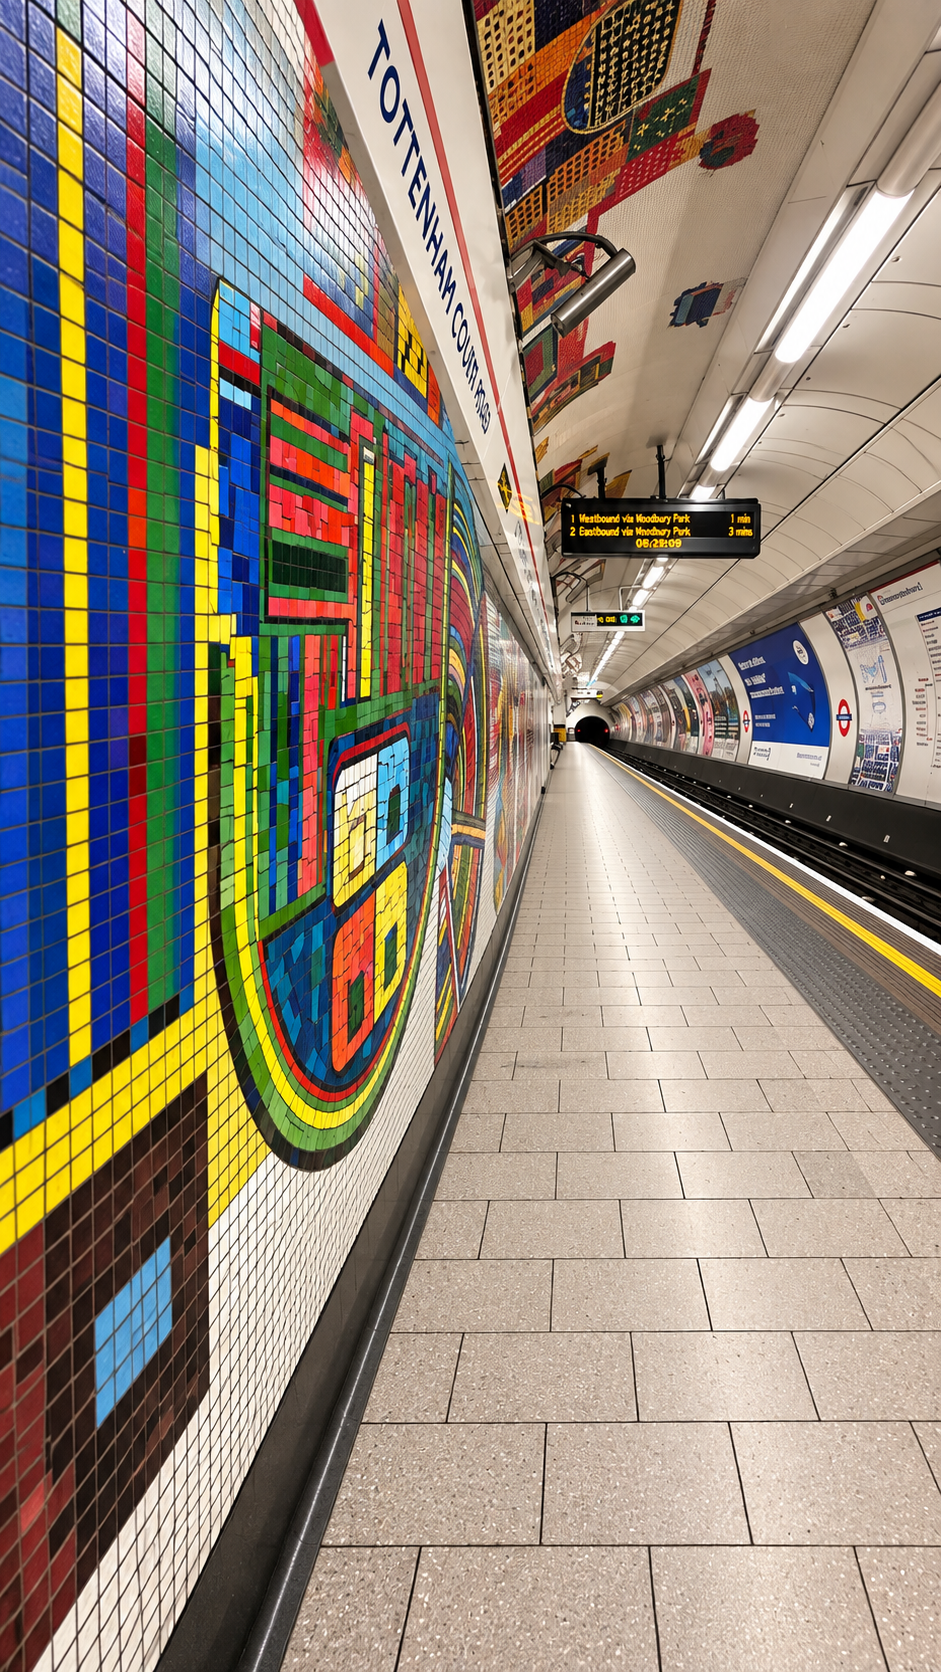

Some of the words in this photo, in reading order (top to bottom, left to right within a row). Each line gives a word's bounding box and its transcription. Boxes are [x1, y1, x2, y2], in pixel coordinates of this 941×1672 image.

[571, 514, 575, 523] 1
[579, 513, 620, 523] Westbound
[621, 513, 634, 523] via
[731, 513, 735, 523] 1
[569, 526, 576, 536] 2
[728, 526, 734, 536] 3
